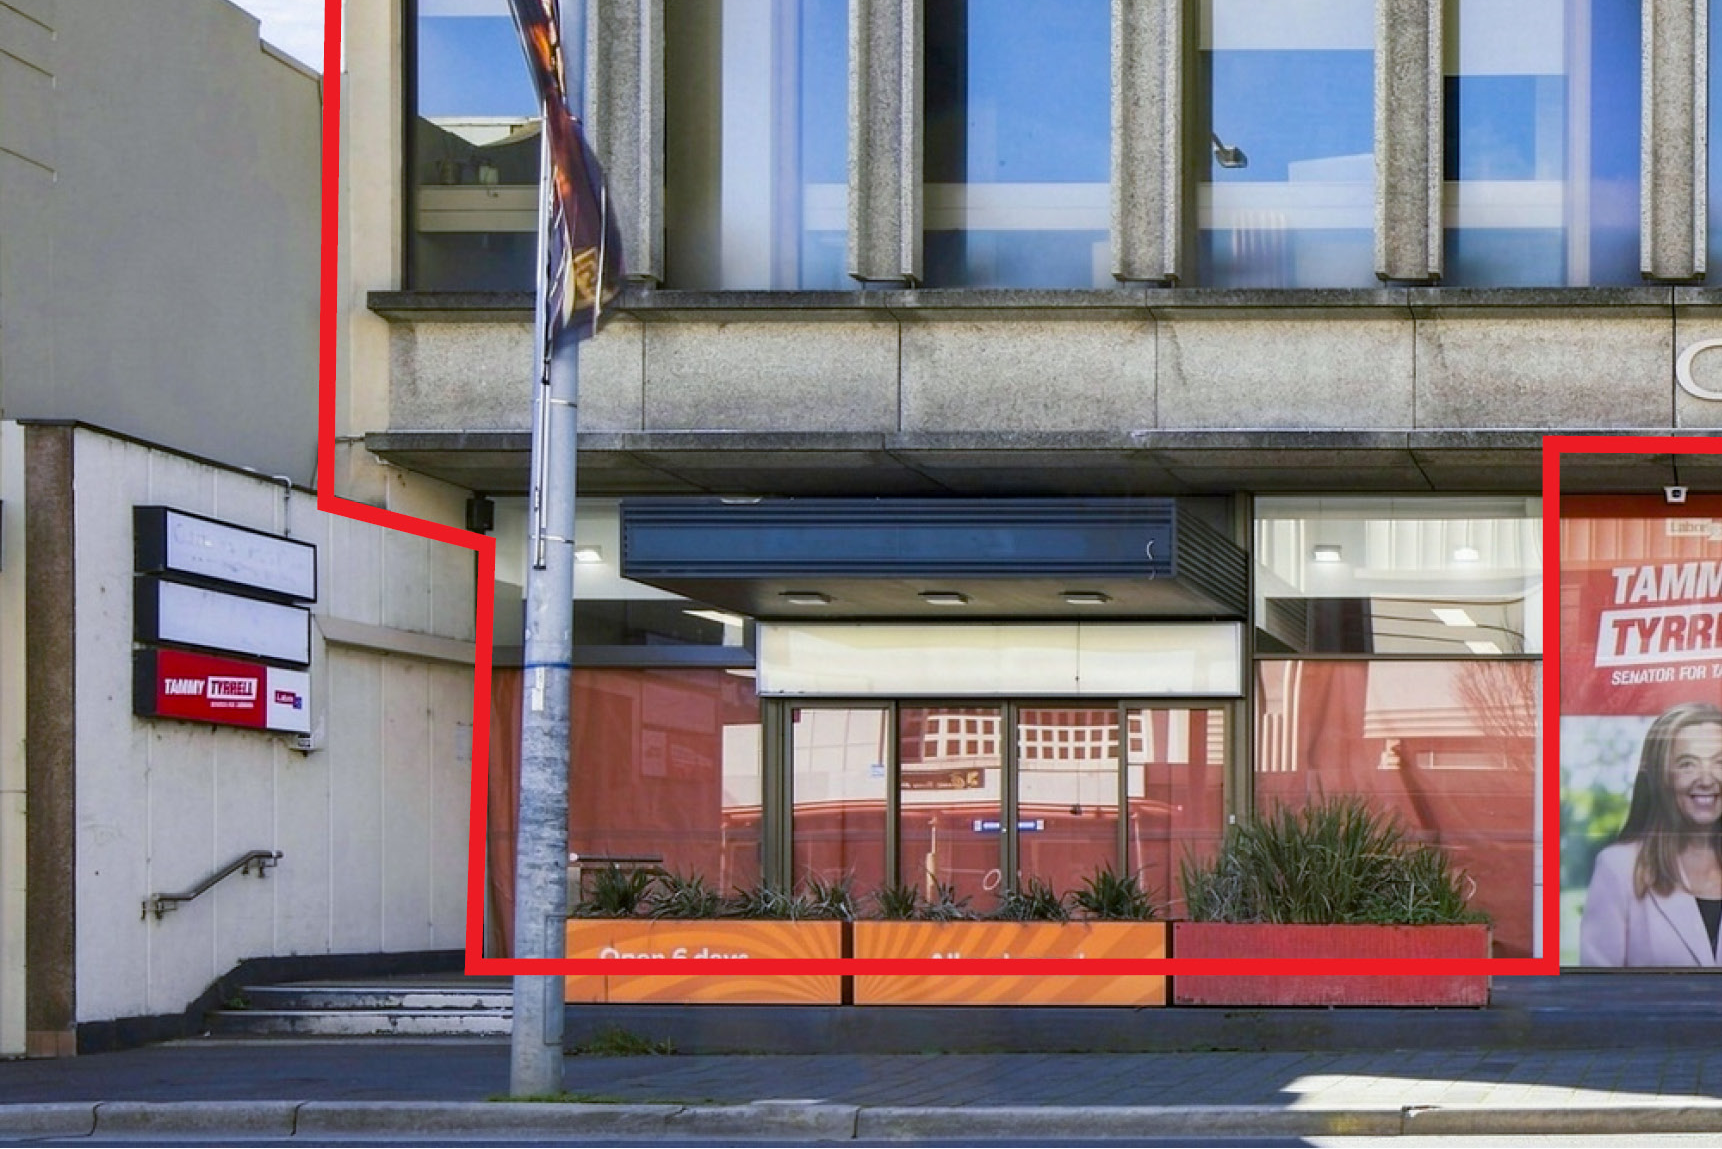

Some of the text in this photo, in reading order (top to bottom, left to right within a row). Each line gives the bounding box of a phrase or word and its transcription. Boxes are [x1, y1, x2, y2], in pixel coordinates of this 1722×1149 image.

[1671, 520, 1708, 533] Labor
[1611, 667, 1674, 685] SENATOR
[1679, 665, 1706, 681] FOR
[164, 678, 253, 696] TAMMY TYRRELL
